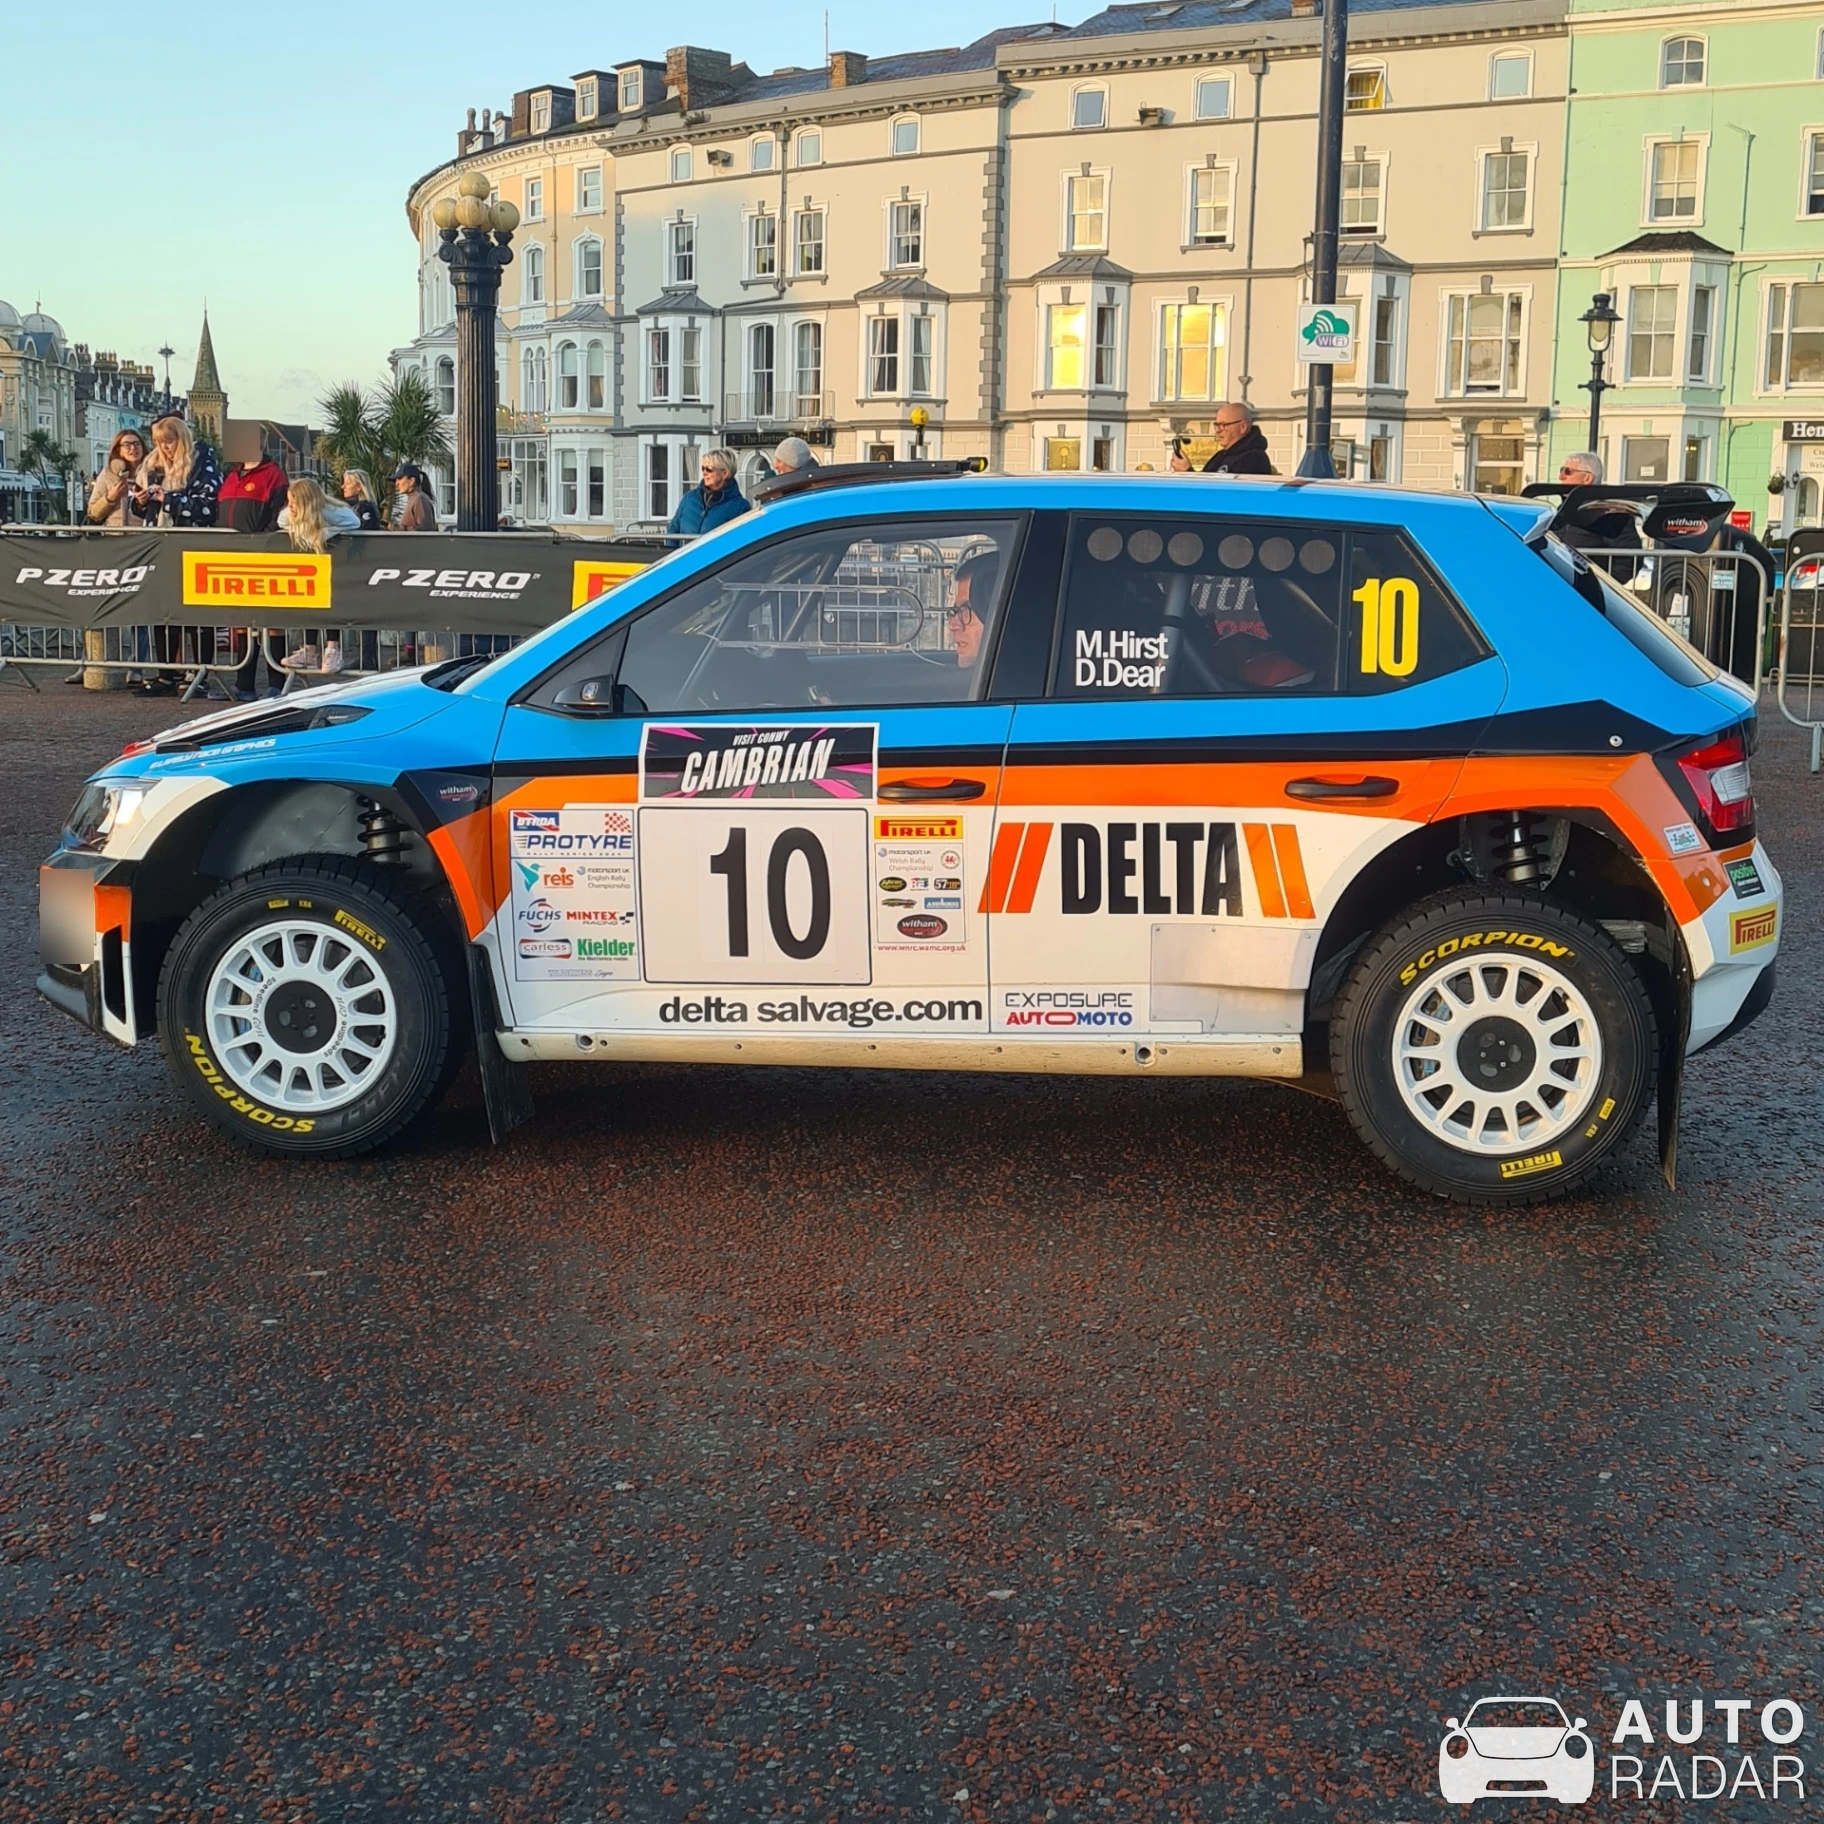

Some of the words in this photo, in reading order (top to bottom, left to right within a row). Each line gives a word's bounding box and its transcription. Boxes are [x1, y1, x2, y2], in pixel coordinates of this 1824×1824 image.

[1667, 518, 1703, 527] witham
[67, 584, 141, 597] EXPERIENCE
[195, 563, 318, 597] PIRELLI
[429, 588, 521, 600] EXPERIENCE
[1352, 577, 1420, 677] 10
[1076, 630, 1169, 659] M.Hirst
[1075, 658, 1166, 688] D.Dear
[732, 734, 756, 746] VISIT
[757, 730, 790, 744] CONWY
[680, 738, 836, 794] CAMBRIAN
[440, 785, 472, 796] witham
[516, 817, 556, 827] BTRDA
[880, 819, 958, 836] PIRELLI
[527, 834, 633, 849] PROTYRE
[543, 866, 575, 886] reis
[1061, 822, 1243, 917] DELTA
[710, 826, 831, 960] 10
[518, 910, 562, 921] FUCHS
[566, 911, 618, 920] MINTEX
[901, 919, 938, 928] witham
[1735, 909, 1776, 945] PIRELLI
[333, 908, 388, 951] PIRELLI
[523, 942, 567, 951] carless
[577, 938, 635, 956] Kielder
[1400, 931, 1568, 986] SCORPION
[252, 976, 277, 1014] speedline
[1005, 992, 1133, 1009] EXPOSURE
[658, 996, 748, 1024] delta
[757, 996, 983, 1028] salvage.com
[323, 1020, 348, 1058] speedline
[185, 1033, 316, 1133] SCORPION
[1500, 1150, 1563, 1179] PIRELLI
